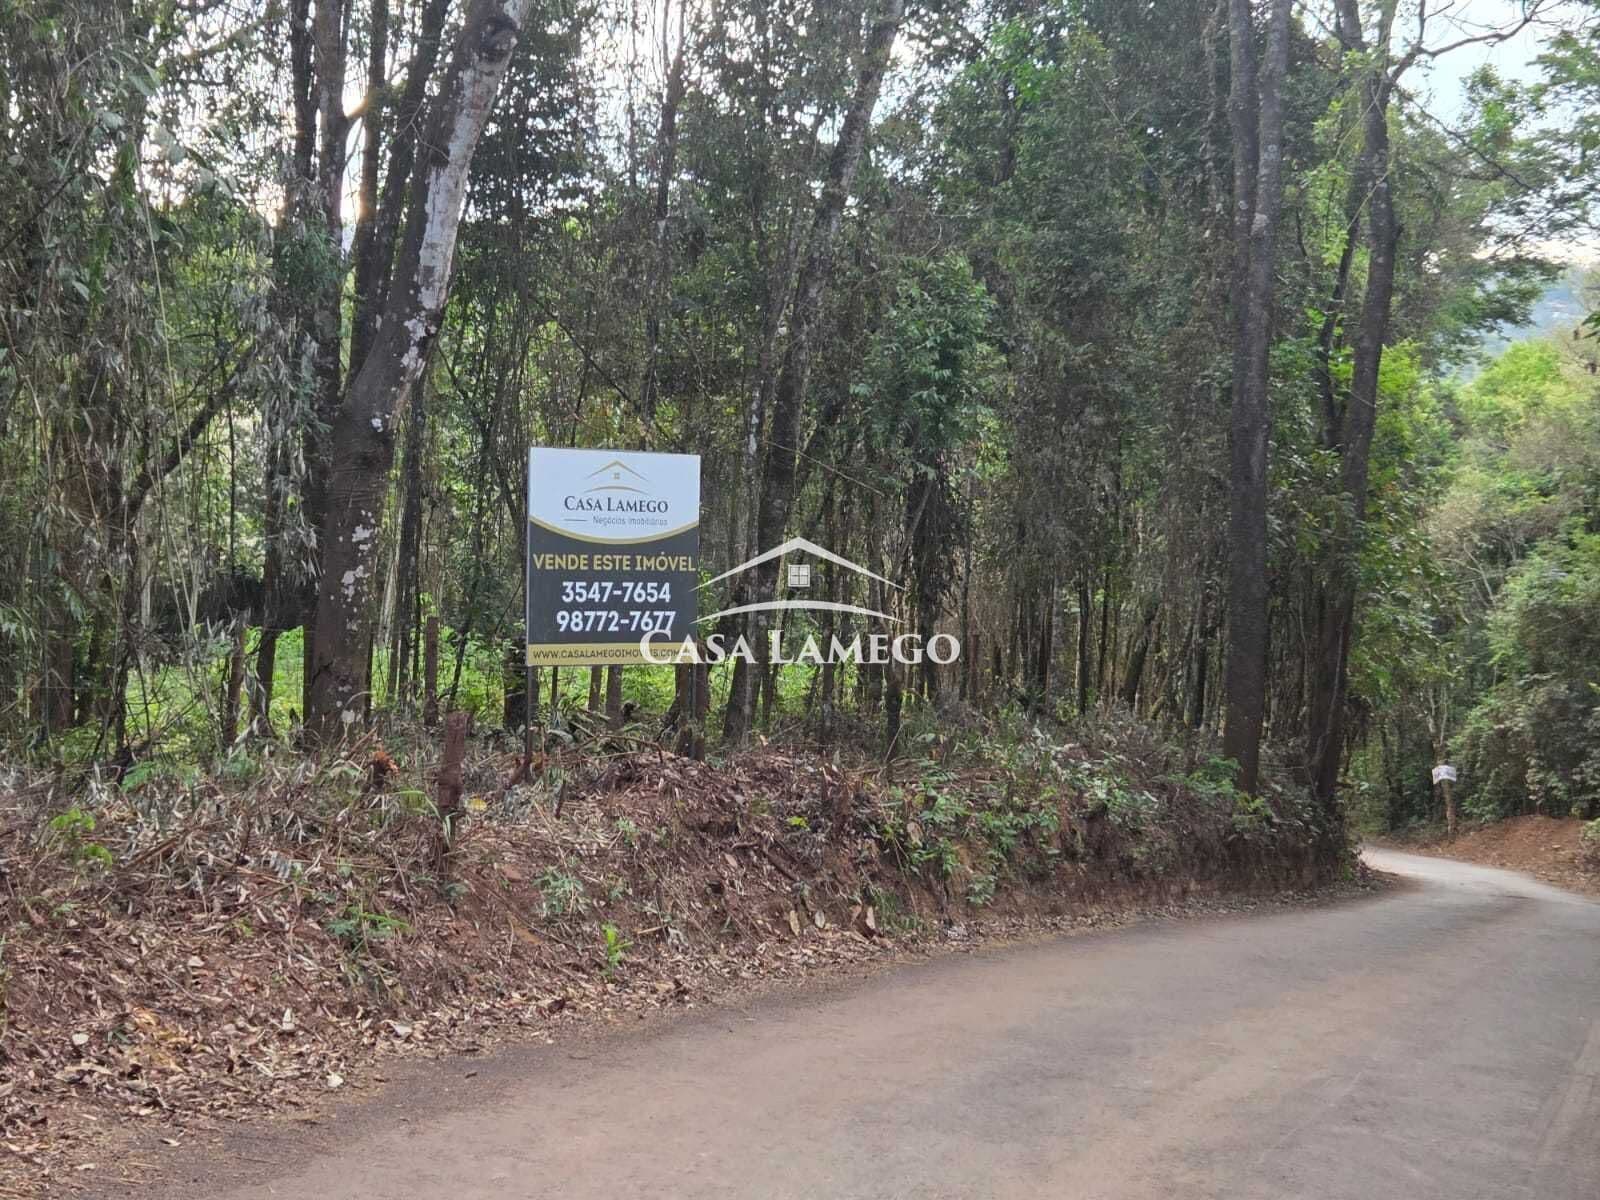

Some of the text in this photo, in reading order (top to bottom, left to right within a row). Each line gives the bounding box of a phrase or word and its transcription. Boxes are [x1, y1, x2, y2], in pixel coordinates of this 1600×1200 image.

[564, 495, 668, 513] CASA LAMEGO
[533, 551, 696, 572] VENDE ESTE IMÓVEL
[562, 581, 671, 602] 3547-7654
[556, 610, 676, 632] 98772-7677
